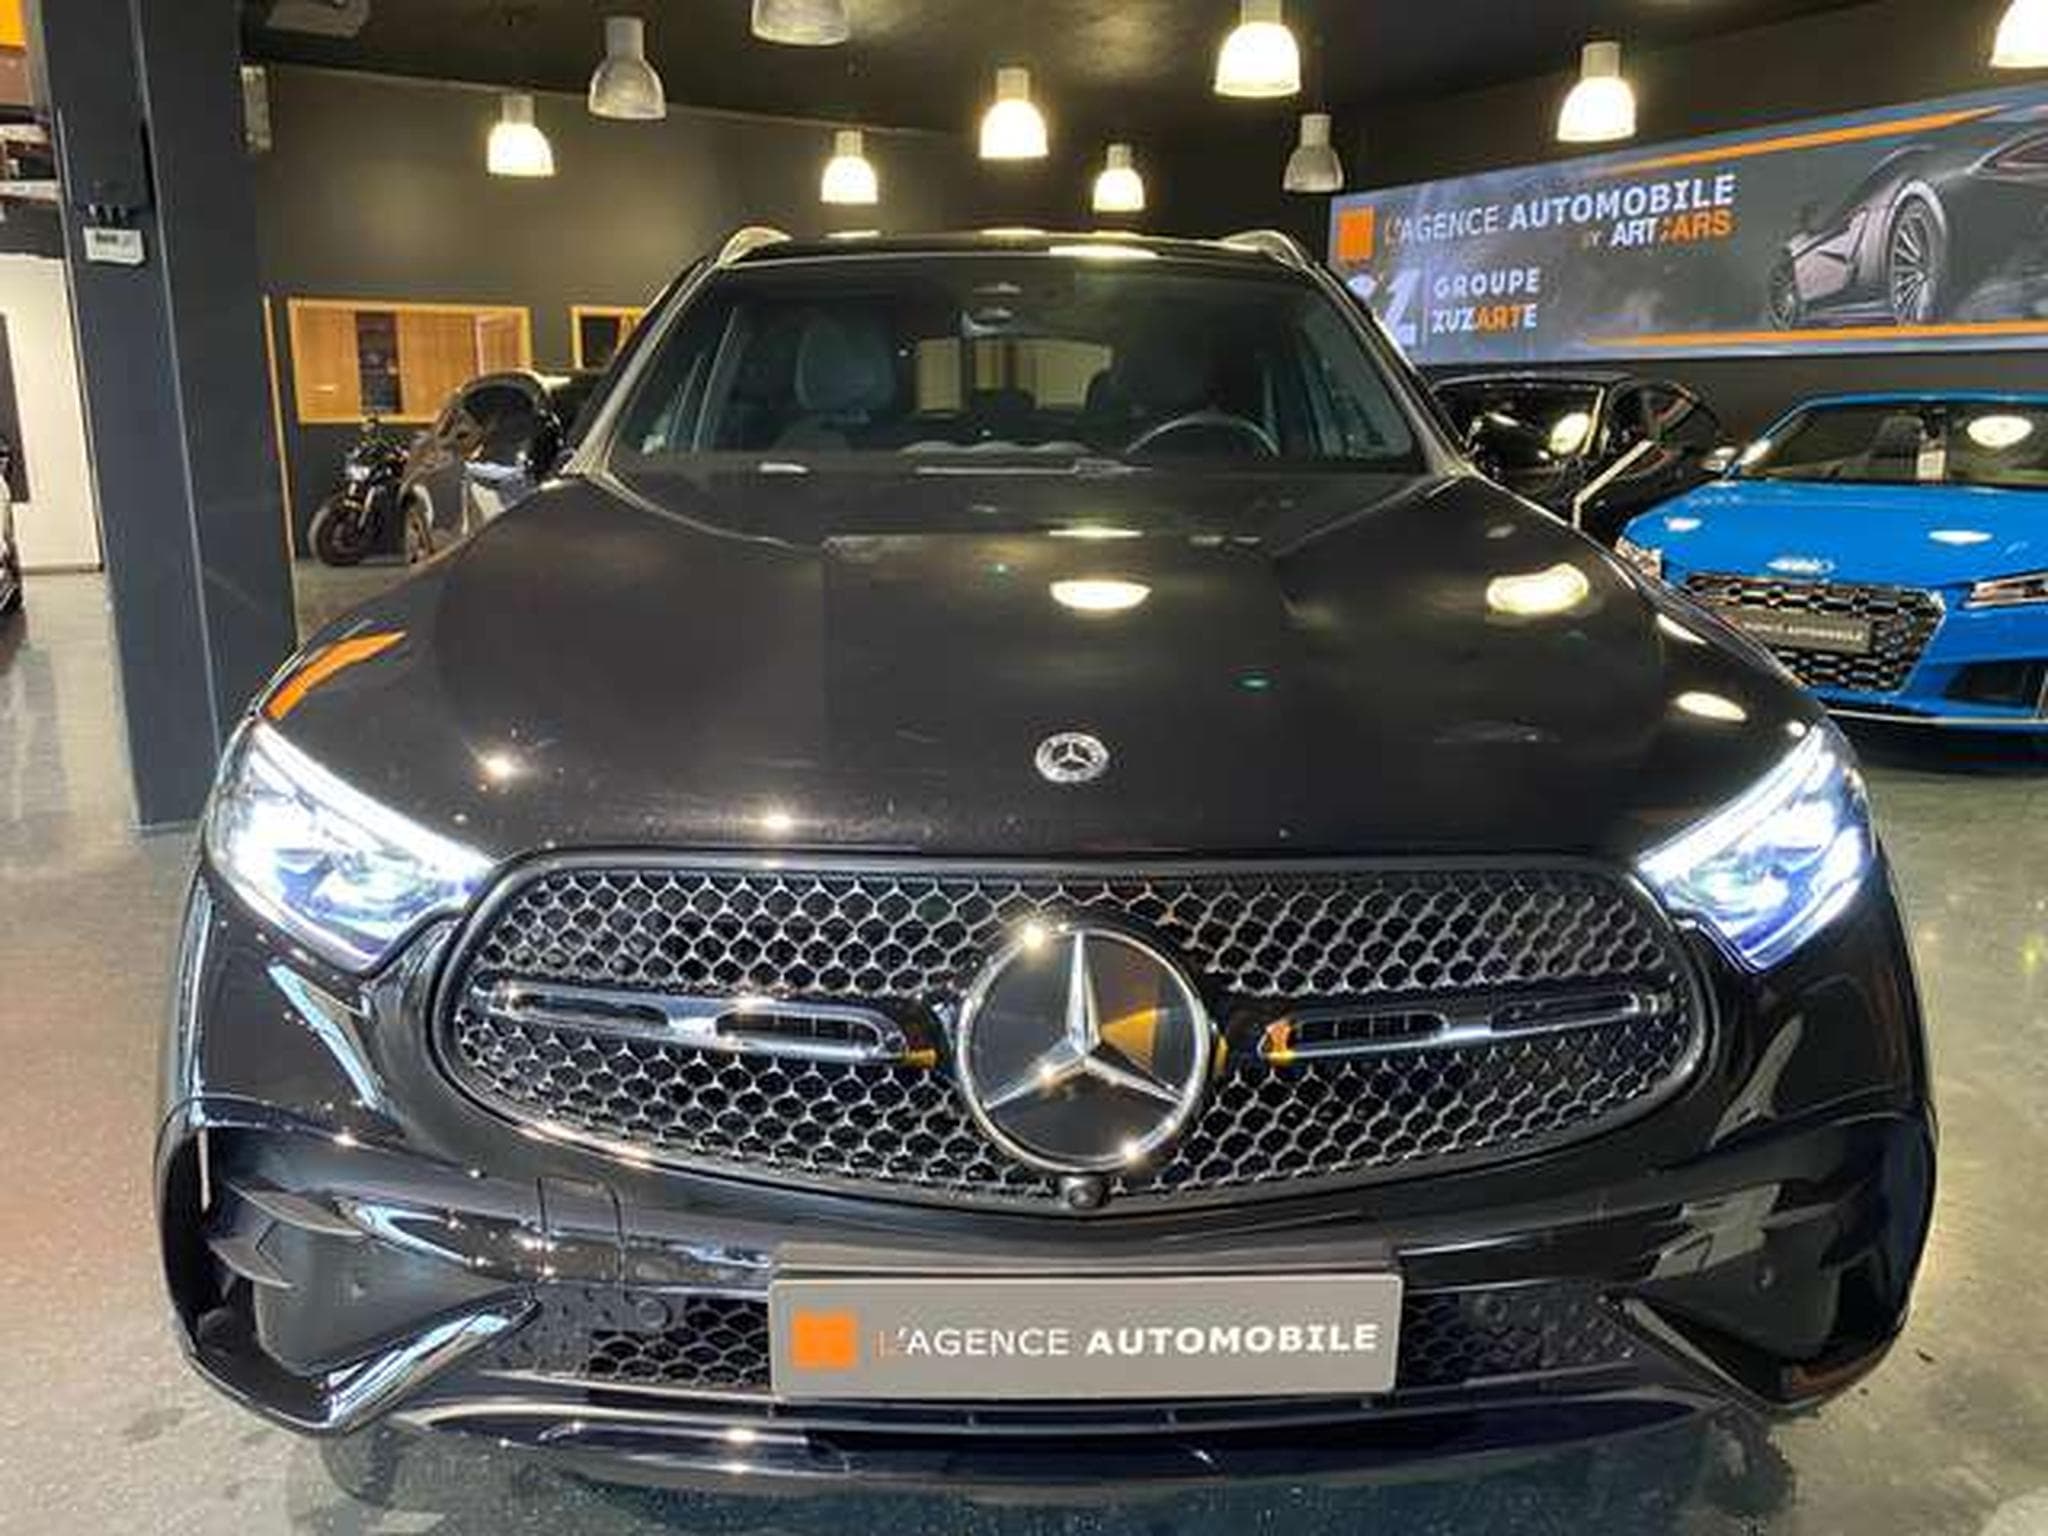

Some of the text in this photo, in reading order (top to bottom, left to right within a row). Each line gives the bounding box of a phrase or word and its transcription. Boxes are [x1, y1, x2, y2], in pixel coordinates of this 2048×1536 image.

[1508, 174, 1736, 231] AUTOMOBILE
[1433, 267, 1541, 299] GROUPE
[1432, 304, 1538, 334] ZUZARTE
[873, 1323, 1379, 1358] L'AGENCE AUTOMOBILE
